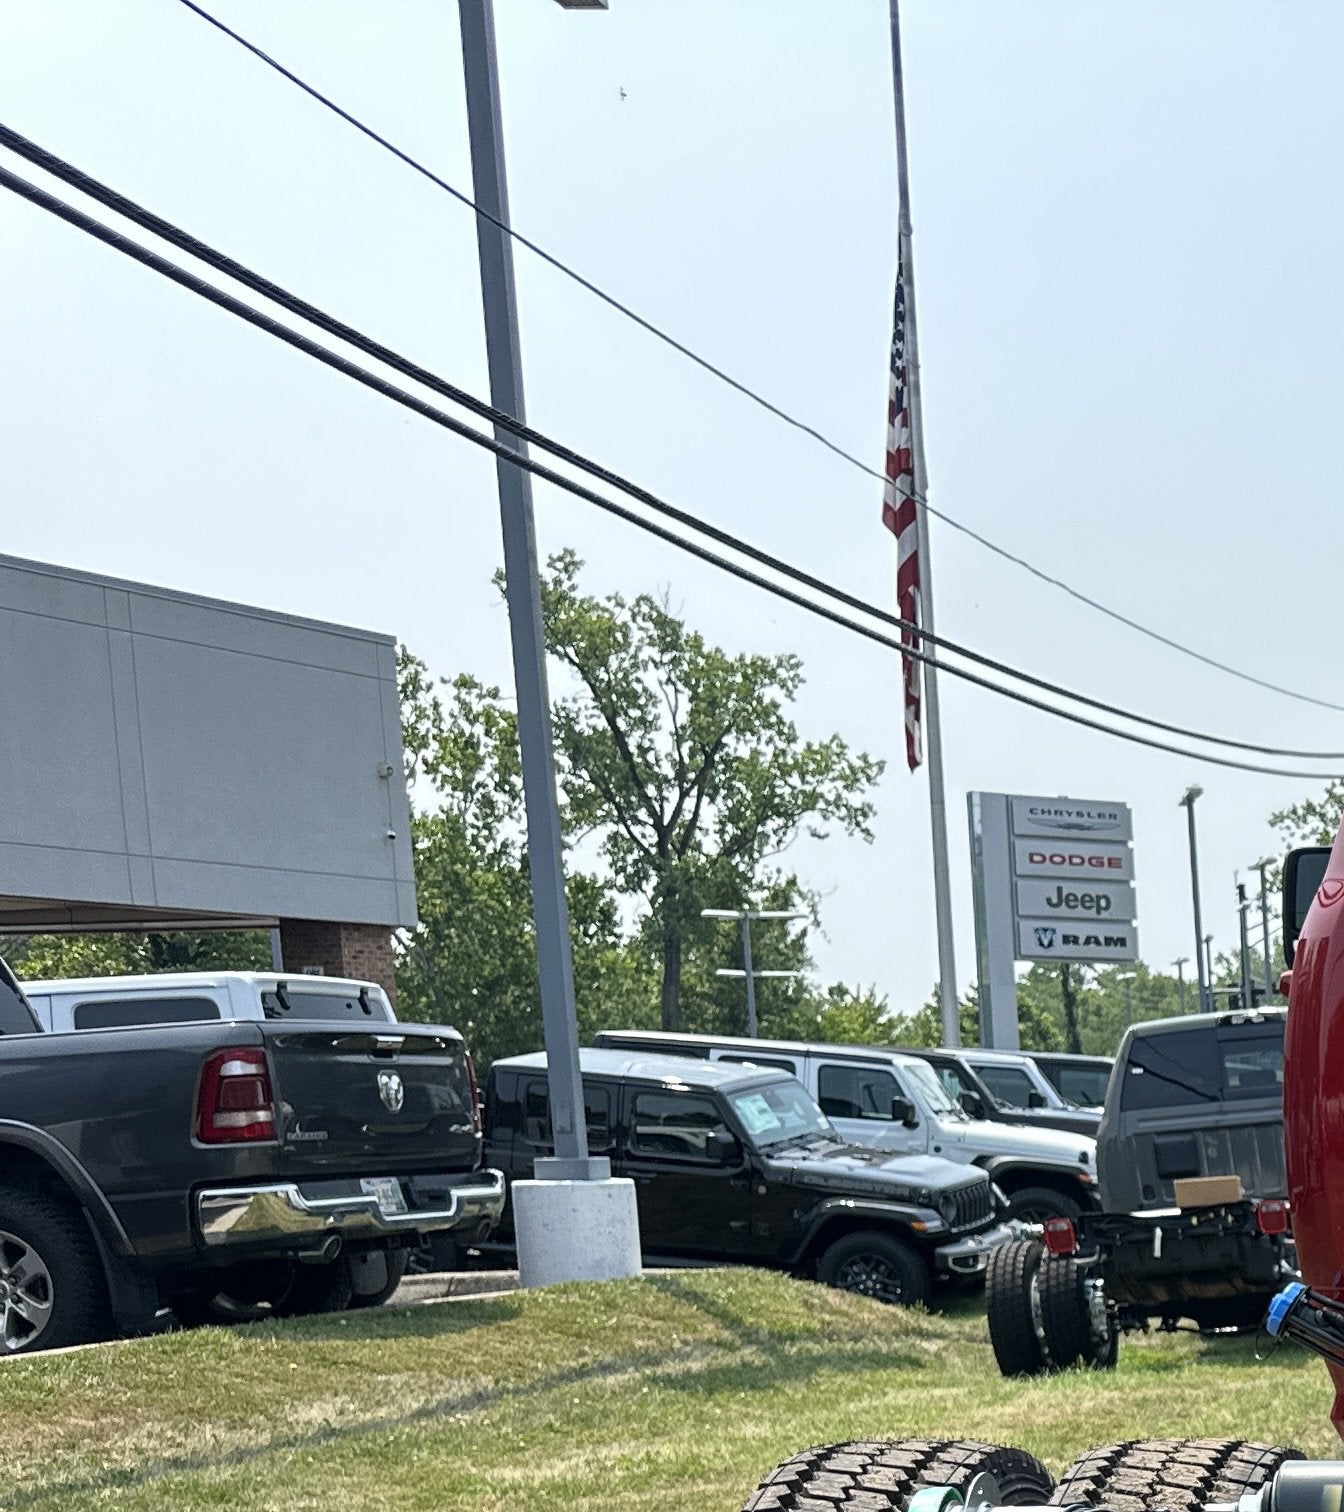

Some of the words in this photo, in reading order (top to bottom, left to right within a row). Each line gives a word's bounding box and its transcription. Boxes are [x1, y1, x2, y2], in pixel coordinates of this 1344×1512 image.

[1029, 807, 1118, 820] CHRYSLER
[1029, 852, 1123, 869] DODGE
[1046, 886, 1112, 915] Jeep
[1062, 934, 1127, 948] RAM
